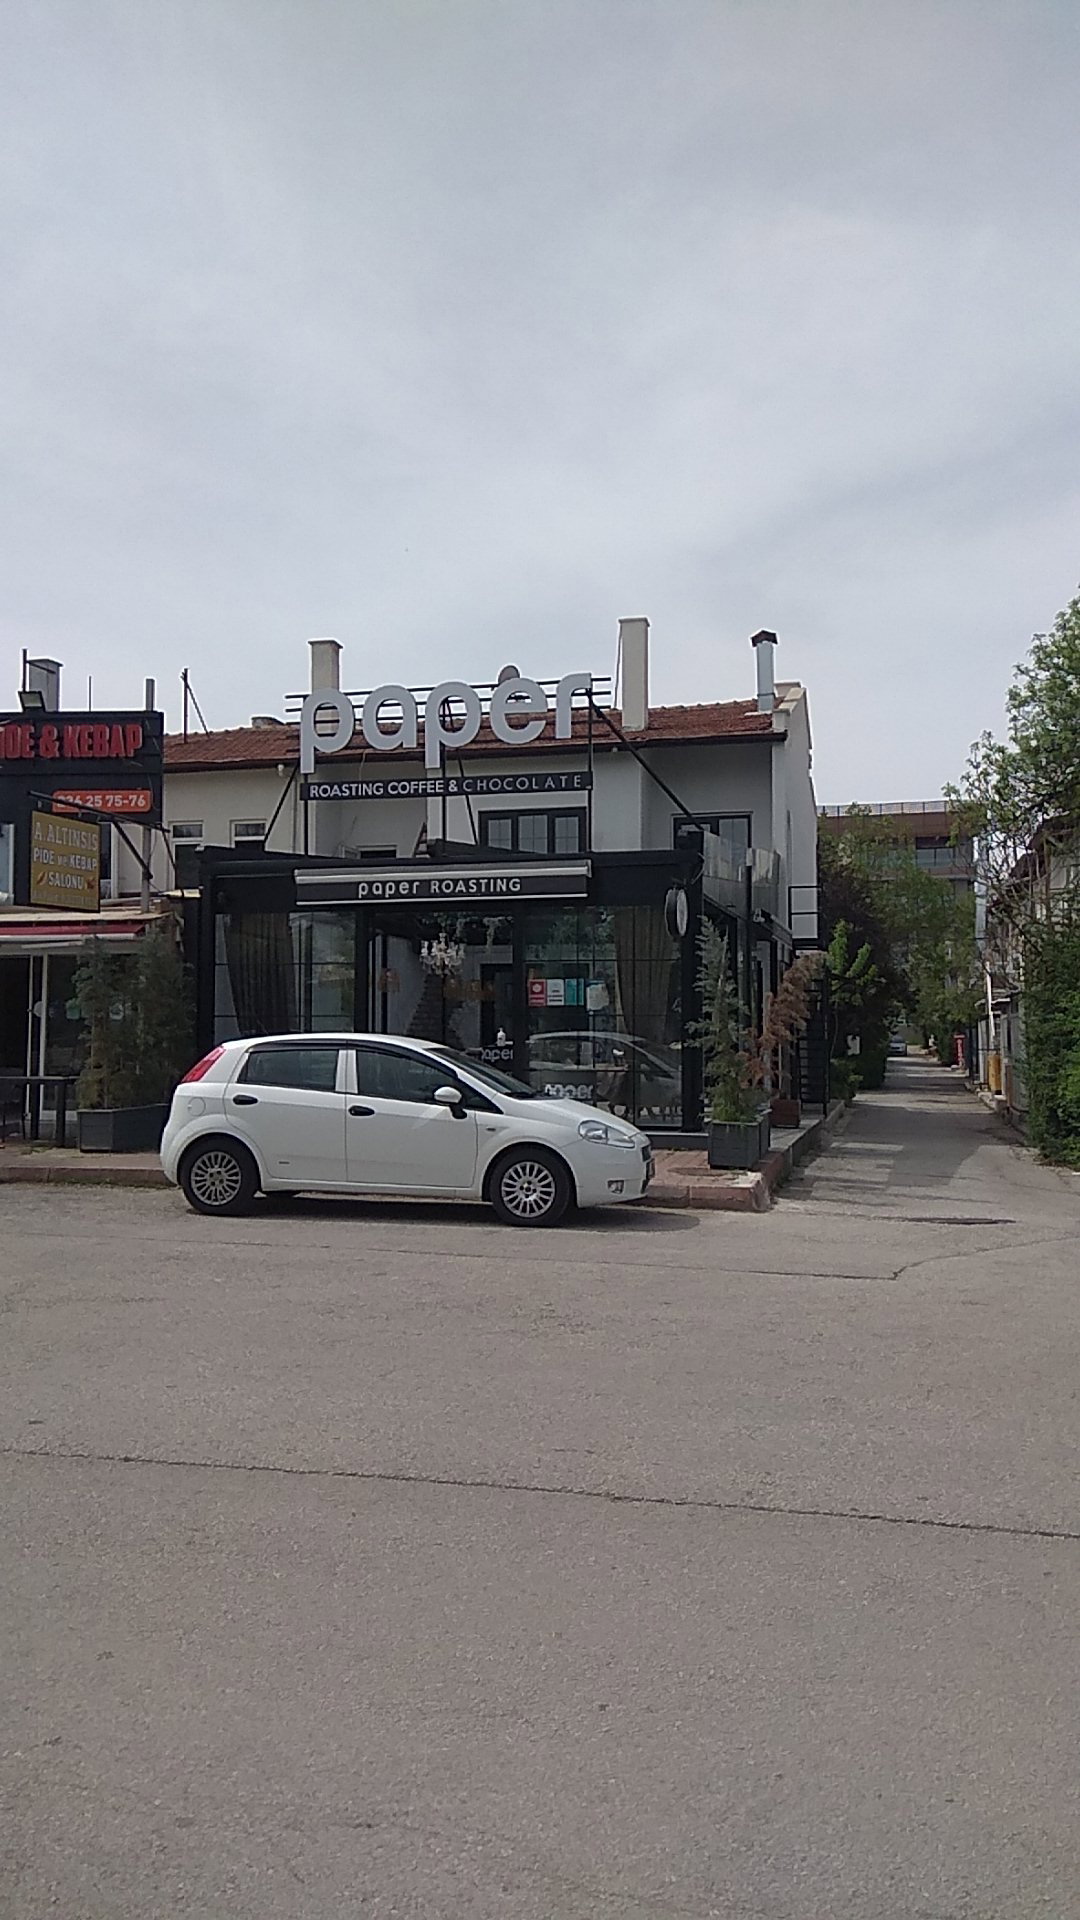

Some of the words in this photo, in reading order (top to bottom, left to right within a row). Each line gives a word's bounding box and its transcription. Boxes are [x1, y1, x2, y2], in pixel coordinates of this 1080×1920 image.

[300, 672, 592, 774] paper
[40, 725, 60, 758] &
[63, 724, 143, 758] KEBAP
[309, 783, 384, 798] ROASTING
[387, 780, 444, 795] COFFEE
[448, 779, 458, 793] &
[462, 775, 582, 792] CHOCOLATE
[105, 794, 146, 808] 75-76
[48, 871, 83, 890] SALONU
[358, 880, 420, 899] paper
[430, 878, 521, 894] ROASTING
